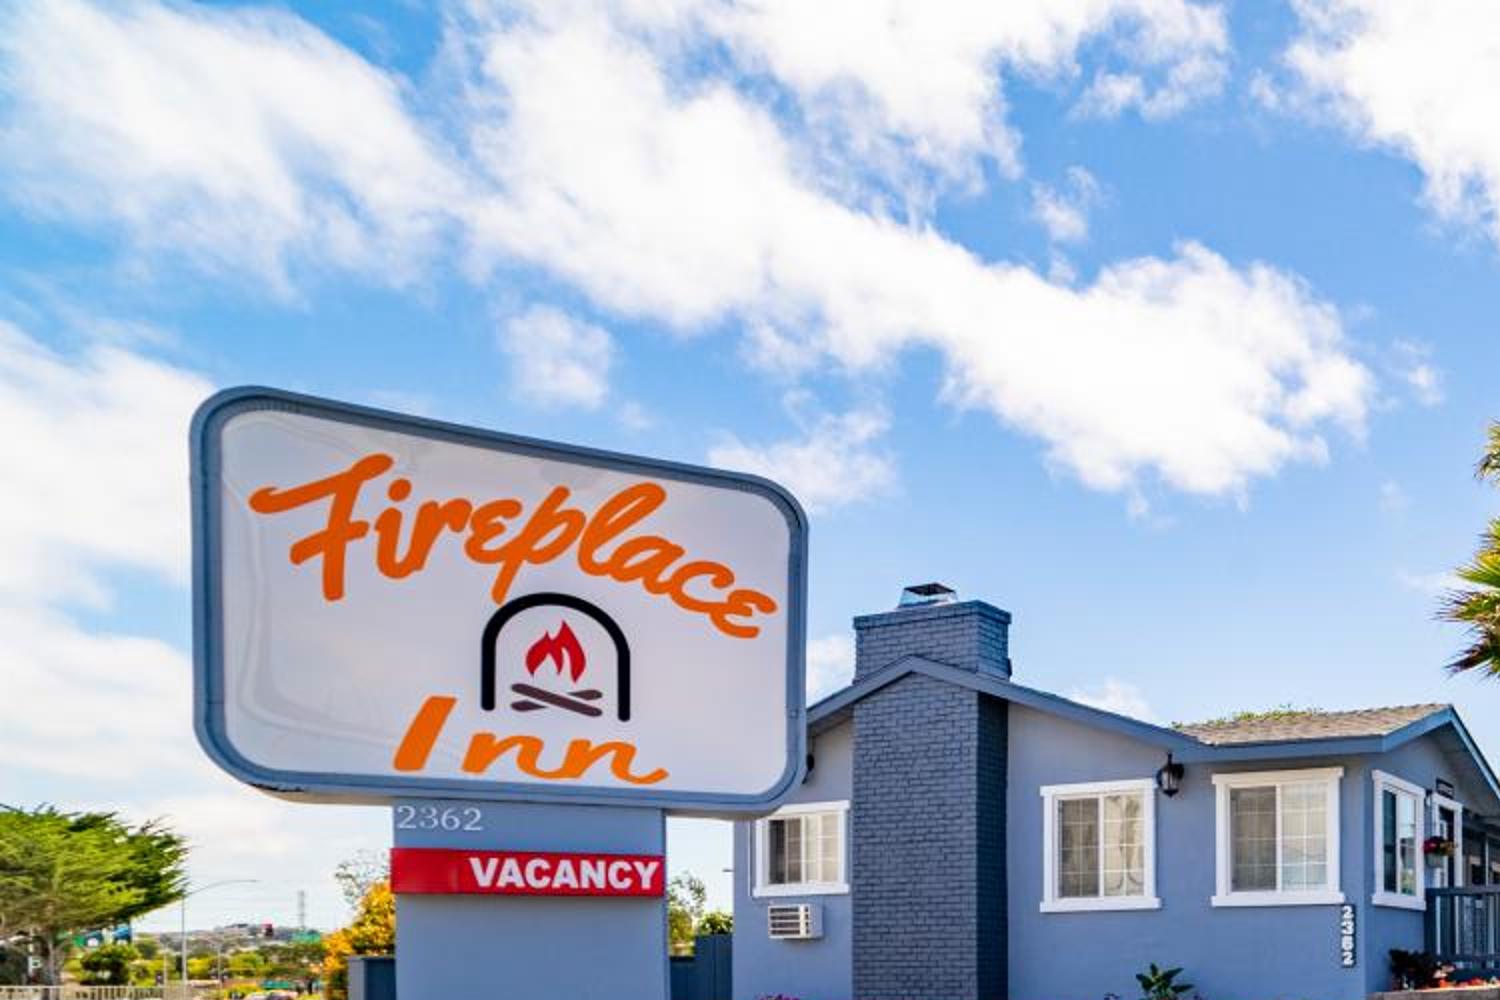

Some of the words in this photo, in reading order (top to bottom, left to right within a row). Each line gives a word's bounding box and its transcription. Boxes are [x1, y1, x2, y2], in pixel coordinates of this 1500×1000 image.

[249, 453, 777, 639] Fireplace
[393, 695, 669, 785] Inn
[397, 805, 484, 831] 2362
[469, 857, 660, 890] VACANCY
[1341, 905, 1354, 966] 2362
